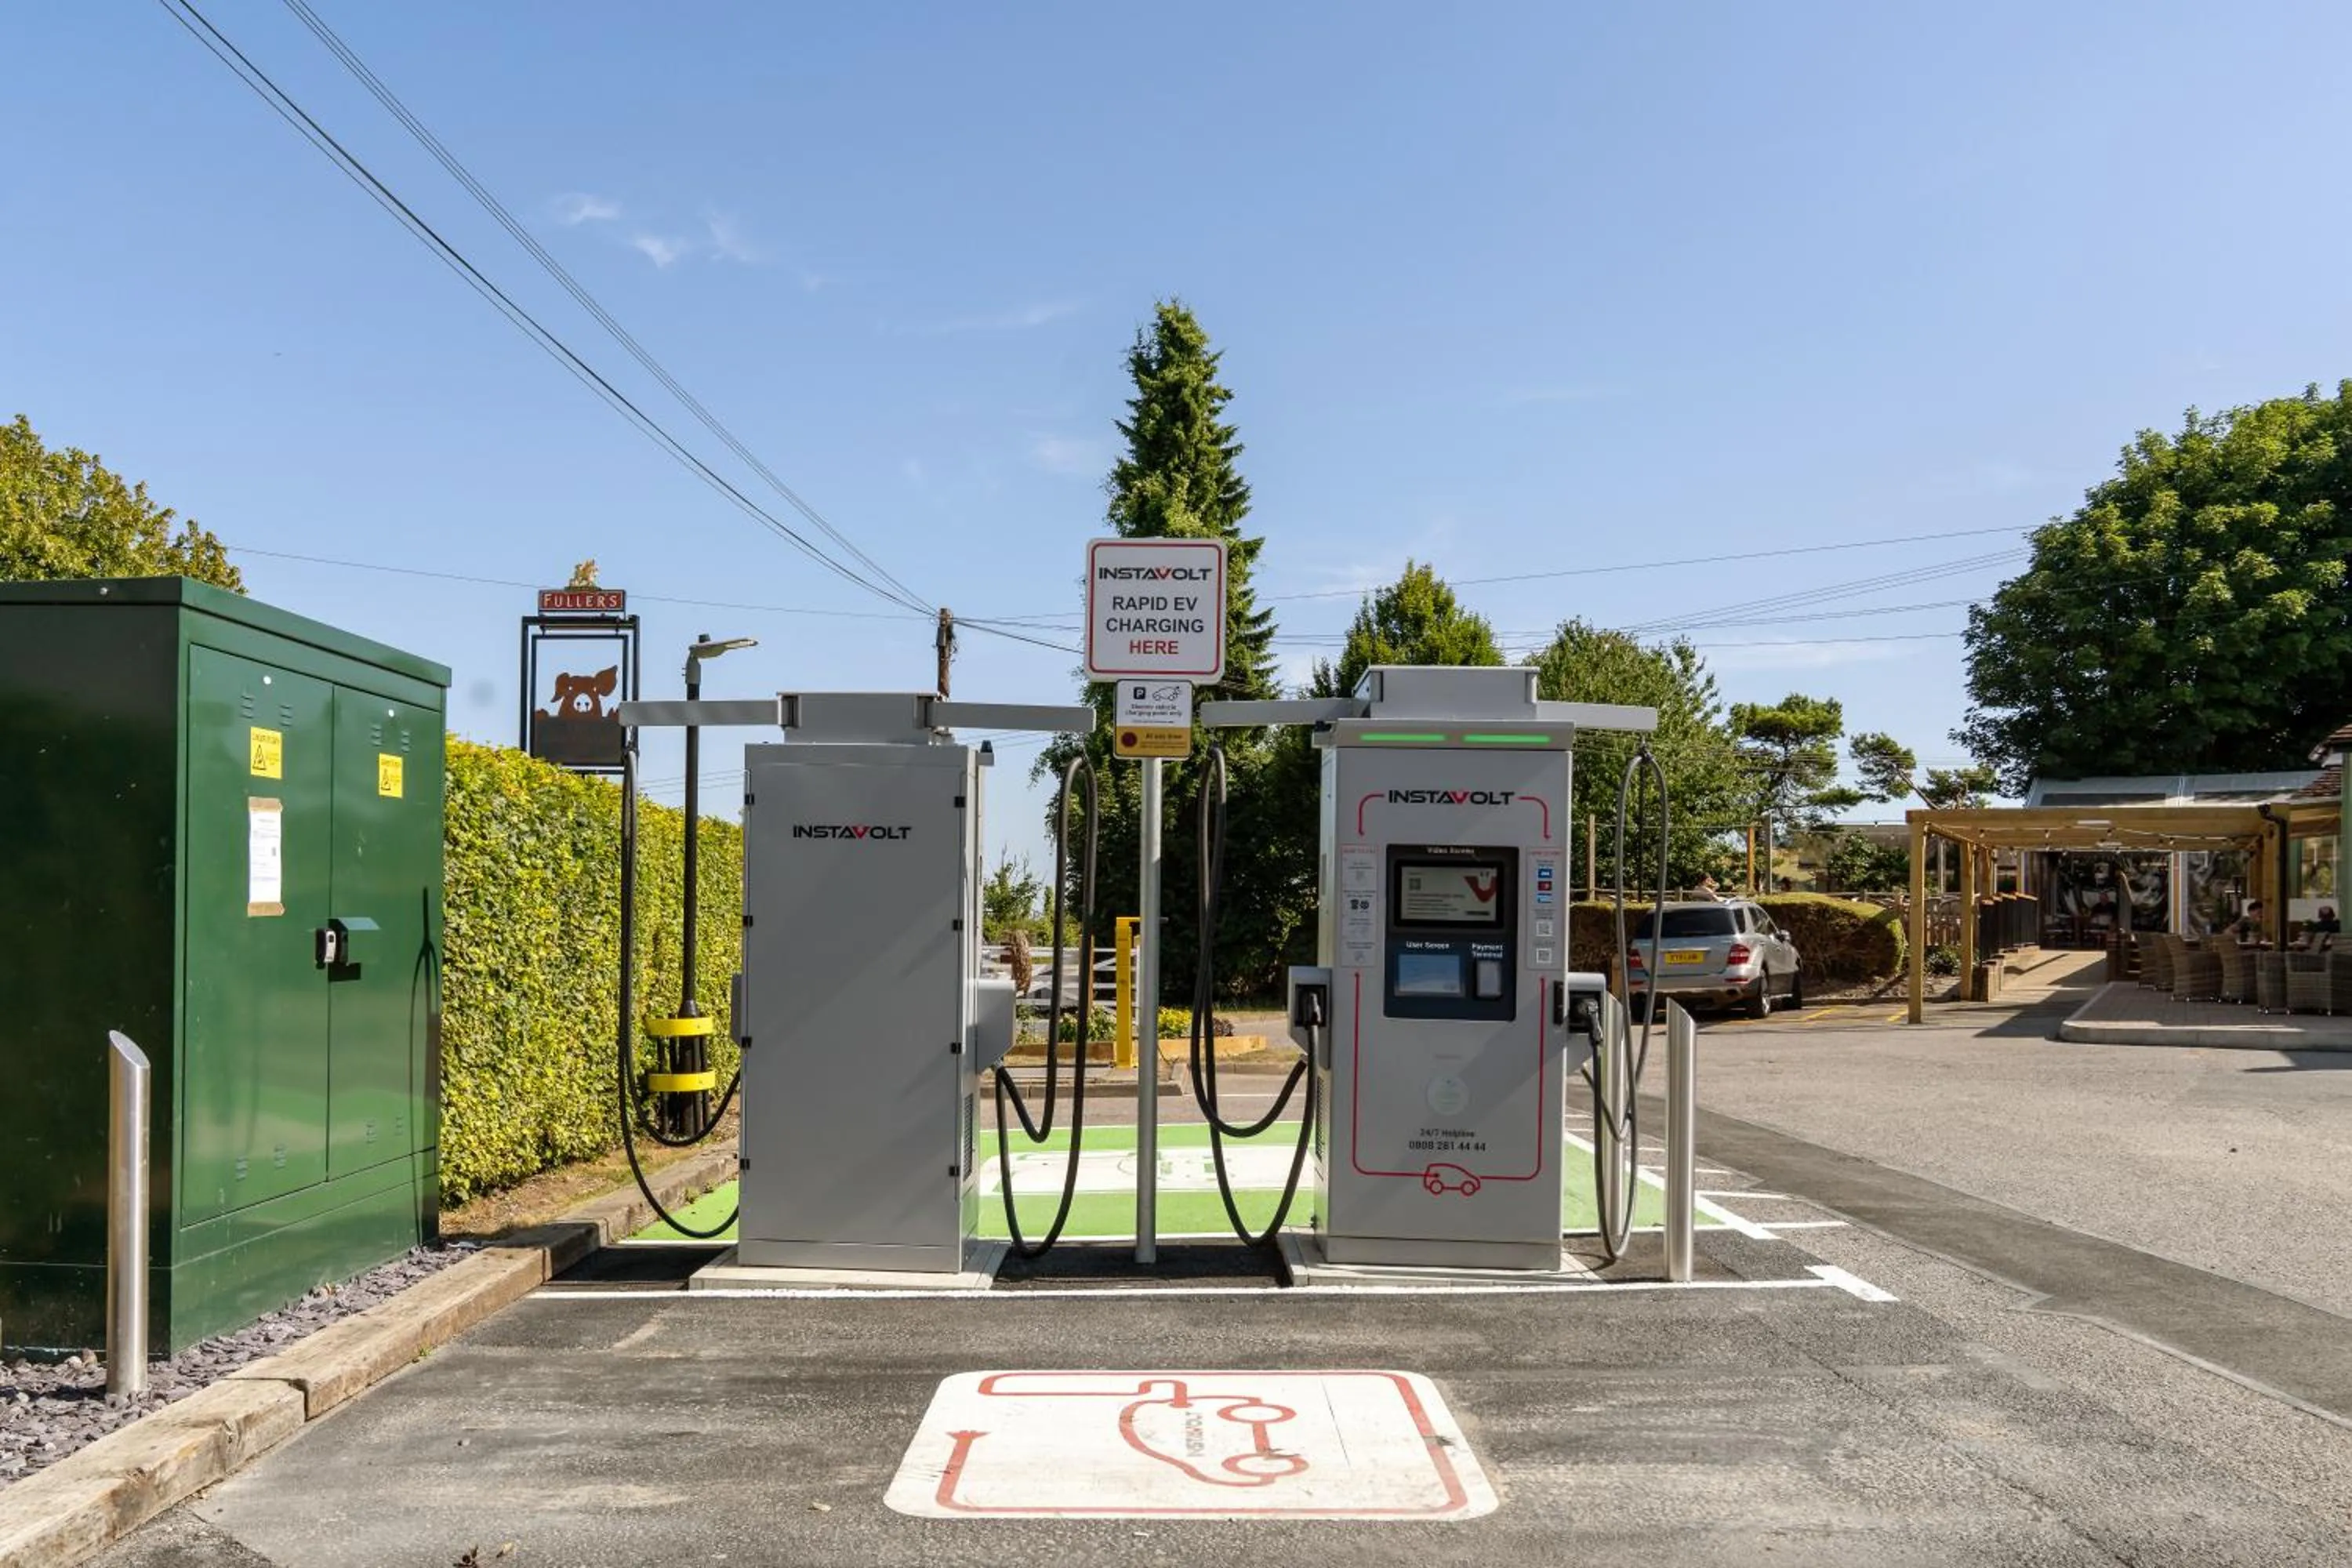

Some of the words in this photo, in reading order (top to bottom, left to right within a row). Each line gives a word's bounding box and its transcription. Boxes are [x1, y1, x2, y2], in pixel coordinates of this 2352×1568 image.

[1098, 566, 1212, 581] INSTAVOLT
[1112, 597, 1167, 611] RAPID
[1173, 597, 1198, 611] EV
[1105, 618, 1204, 633] CHARGING
[1129, 641, 1179, 655] HERE
[1388, 789, 1515, 805] INSTAVOLT
[793, 825, 912, 840] INSTAVOLT
[1472, 942, 1503, 951] Payment
[1420, 1128, 1439, 1137] 24/7
